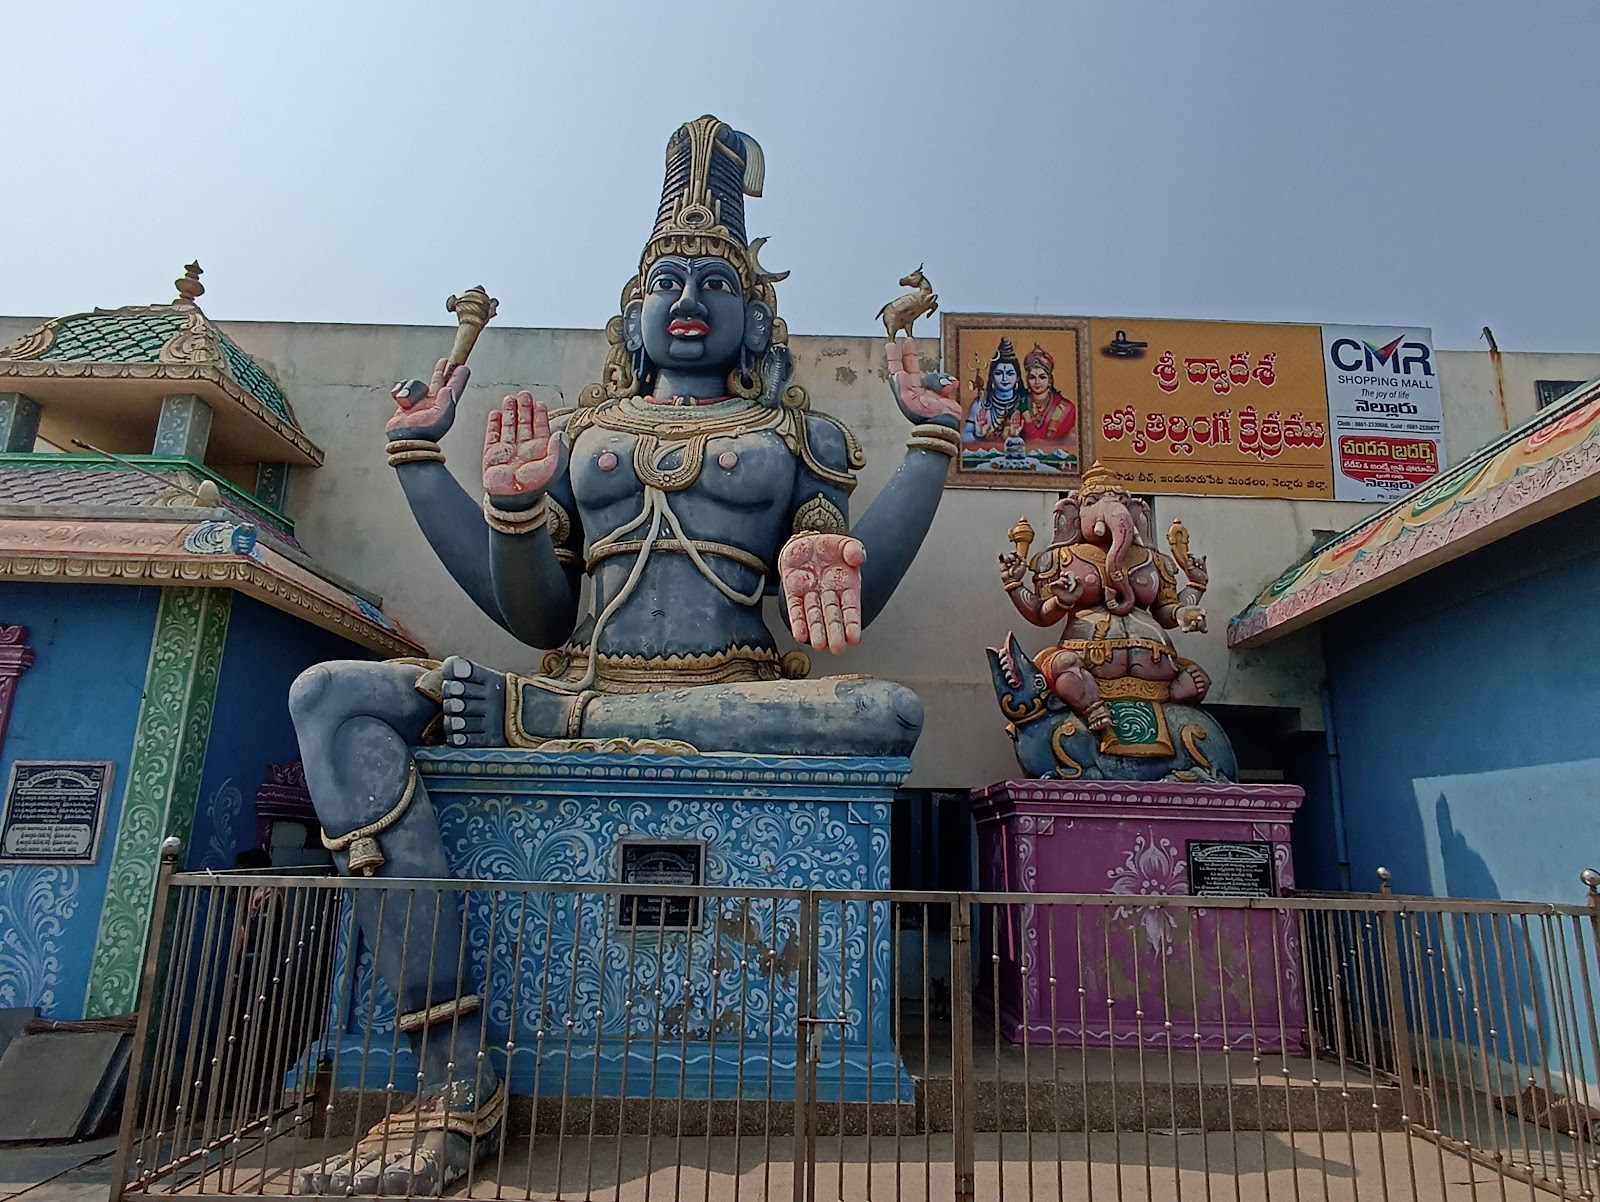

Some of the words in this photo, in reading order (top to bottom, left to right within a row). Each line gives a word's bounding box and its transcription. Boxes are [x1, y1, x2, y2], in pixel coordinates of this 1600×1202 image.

[1331, 333, 1435, 376] CMR
[1152, 351, 1180, 394] శ్రీ
[1184, 351, 1277, 395] ద్వాదశ
[1338, 375, 1398, 387] SHOPPING
[1401, 379, 1433, 389] MALL
[1361, 388, 1374, 397] The
[1376, 390, 1388, 399] joy
[1398, 391, 1410, 399] life
[1355, 399, 1418, 417] నెల్లూరు
[1102, 405, 1233, 455] జ్యోతిర్లింగ
[1237, 405, 1327, 461] క్షేత్రము
[1342, 440, 1389, 456] చందన
[1392, 443, 1435, 463] బ్రదర్స్
[1272, 478, 1303, 490] నెల్లూరు
[1365, 479, 1415, 491] నెల్లూరు
